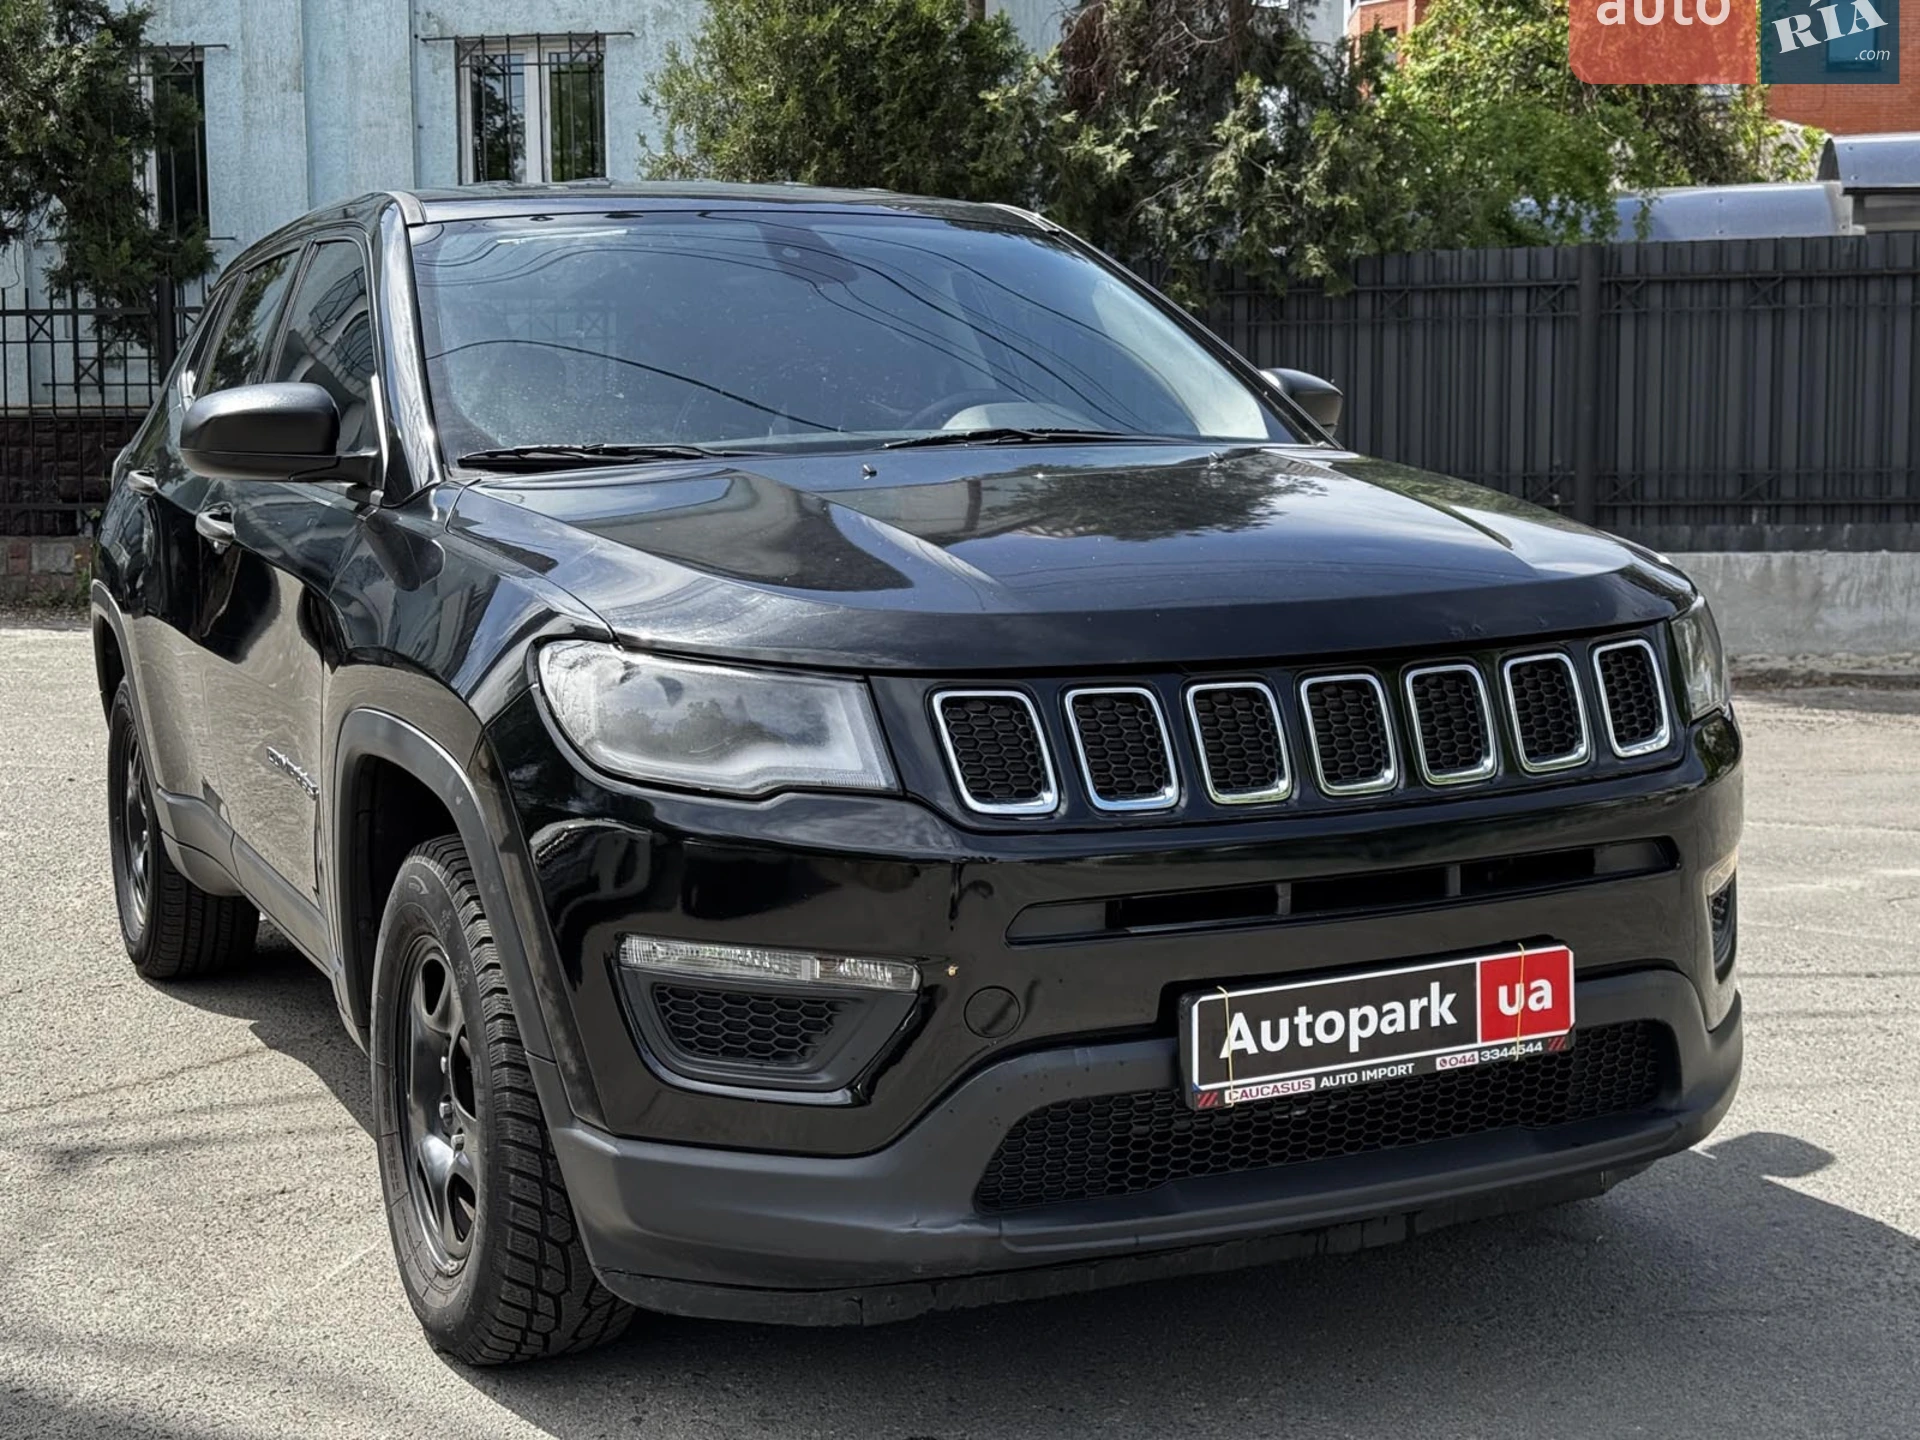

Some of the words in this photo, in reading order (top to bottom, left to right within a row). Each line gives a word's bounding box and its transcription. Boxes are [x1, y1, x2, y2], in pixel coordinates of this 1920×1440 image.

[1219, 982, 1458, 1059] Autopark
[1497, 978, 1553, 1016] ua
[1228, 1080, 1312, 1101] CAUCASUS
[1319, 1072, 1358, 1088] AUTO
[1361, 1063, 1415, 1082] IMPORT
